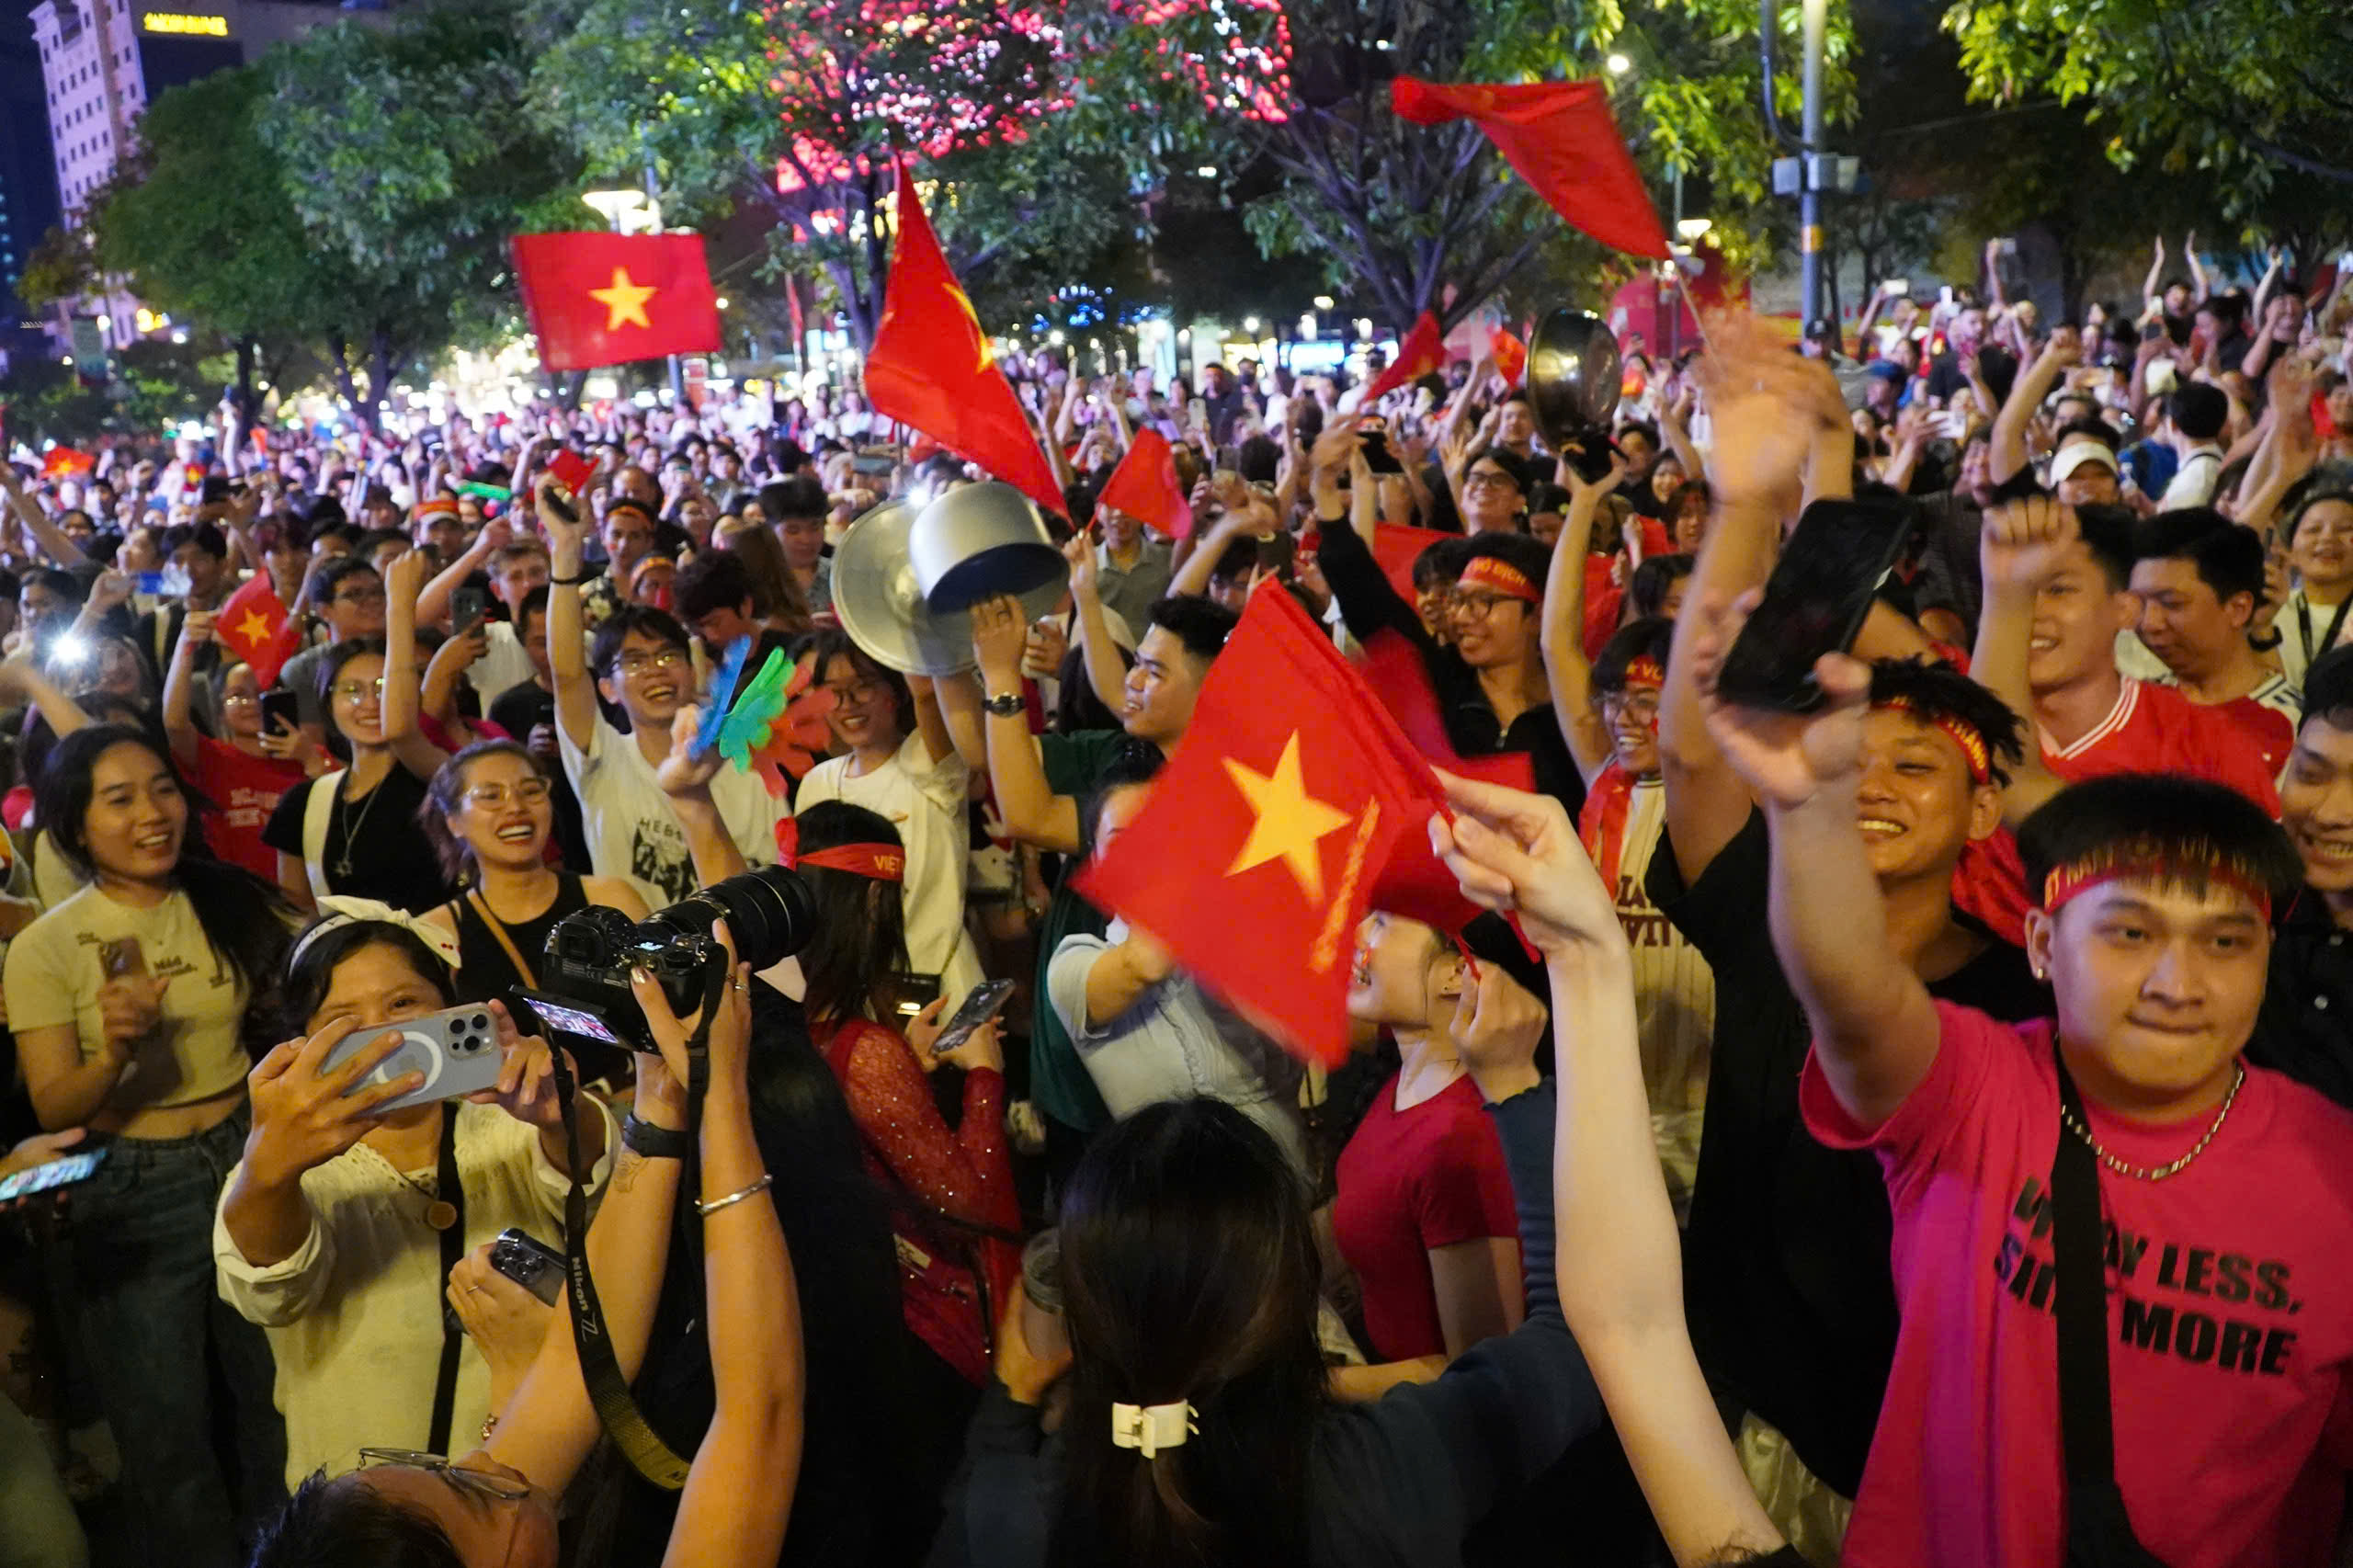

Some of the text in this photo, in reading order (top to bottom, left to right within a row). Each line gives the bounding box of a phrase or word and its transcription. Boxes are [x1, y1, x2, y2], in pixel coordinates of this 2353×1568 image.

[572, 1256, 589, 1312] Nikon
[2157, 1244, 2304, 1315] LESS,
[2120, 1295, 2297, 1377] MORE
